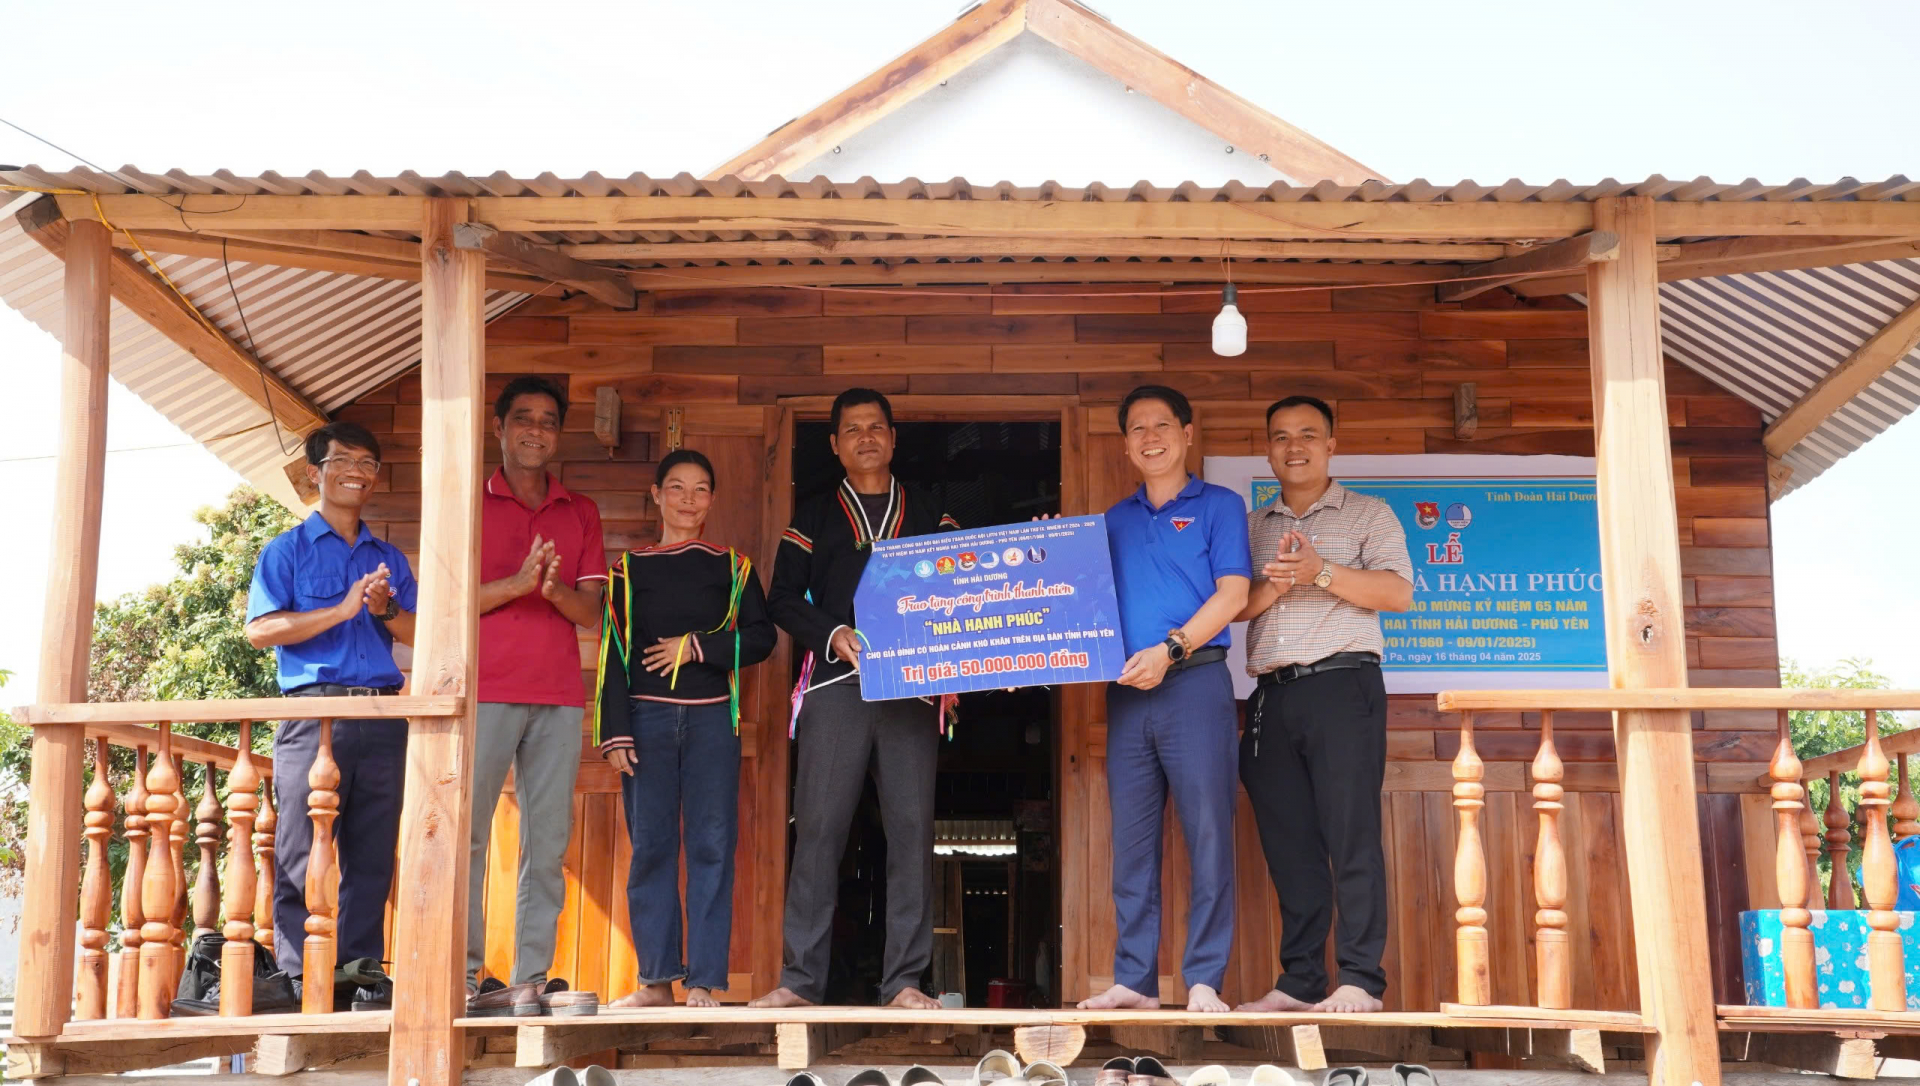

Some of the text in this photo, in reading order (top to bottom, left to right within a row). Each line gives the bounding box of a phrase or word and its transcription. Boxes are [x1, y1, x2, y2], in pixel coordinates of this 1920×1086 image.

[1514, 491, 1543, 502] Đoàn
[1426, 532, 1463, 564] LỄ
[984, 571, 1009, 582] DƯƠNG
[1438, 573, 1518, 597] HẠNH
[897, 578, 1075, 616] Trao tặng công trình thanh niên
[1430, 599, 1471, 612] MỪNG
[1496, 598, 1532, 614] NIỆM
[1535, 601, 1552, 612] 65
[1555, 598, 1588, 612] NĂM
[964, 614, 1004, 634] HẠNH
[1384, 618, 1407, 630] HAI
[1410, 615, 1442, 630] TỈNH
[1445, 614, 1468, 630] HẢI
[1471, 617, 1518, 630] DƯƠNG
[1531, 616, 1558, 630] PHÚ
[1561, 615, 1589, 630] YÊN
[866, 651, 882, 660] CHO
[882, 648, 896, 658] GIA
[897, 645, 916, 657] ĐÌNH
[916, 643, 928, 655] CÓ
[928, 642, 950, 653] HOÀN
[950, 638, 972, 651] CẢNH
[973, 635, 989, 649] KHÓ
[990, 635, 1011, 646] KHĂN
[1011, 631, 1034, 644] TRÊN
[1032, 632, 1046, 644] ĐỊA
[1046, 629, 1063, 641] BÀN
[1064, 627, 1082, 640] TỈNH
[1099, 625, 1115, 637] YÊN
[1456, 636, 1537, 649] 09/01/2025)
[902, 649, 1089, 685] Trị giá: 50.000.000 đồng
[1389, 652, 1406, 663] Pa,
[1408, 652, 1432, 664] ngày
[1434, 652, 1447, 662] 16
[1448, 652, 1477, 664] tháng
[1479, 652, 1492, 662] 04
[1493, 652, 1516, 662] năm
[1517, 652, 1542, 662] 2025
